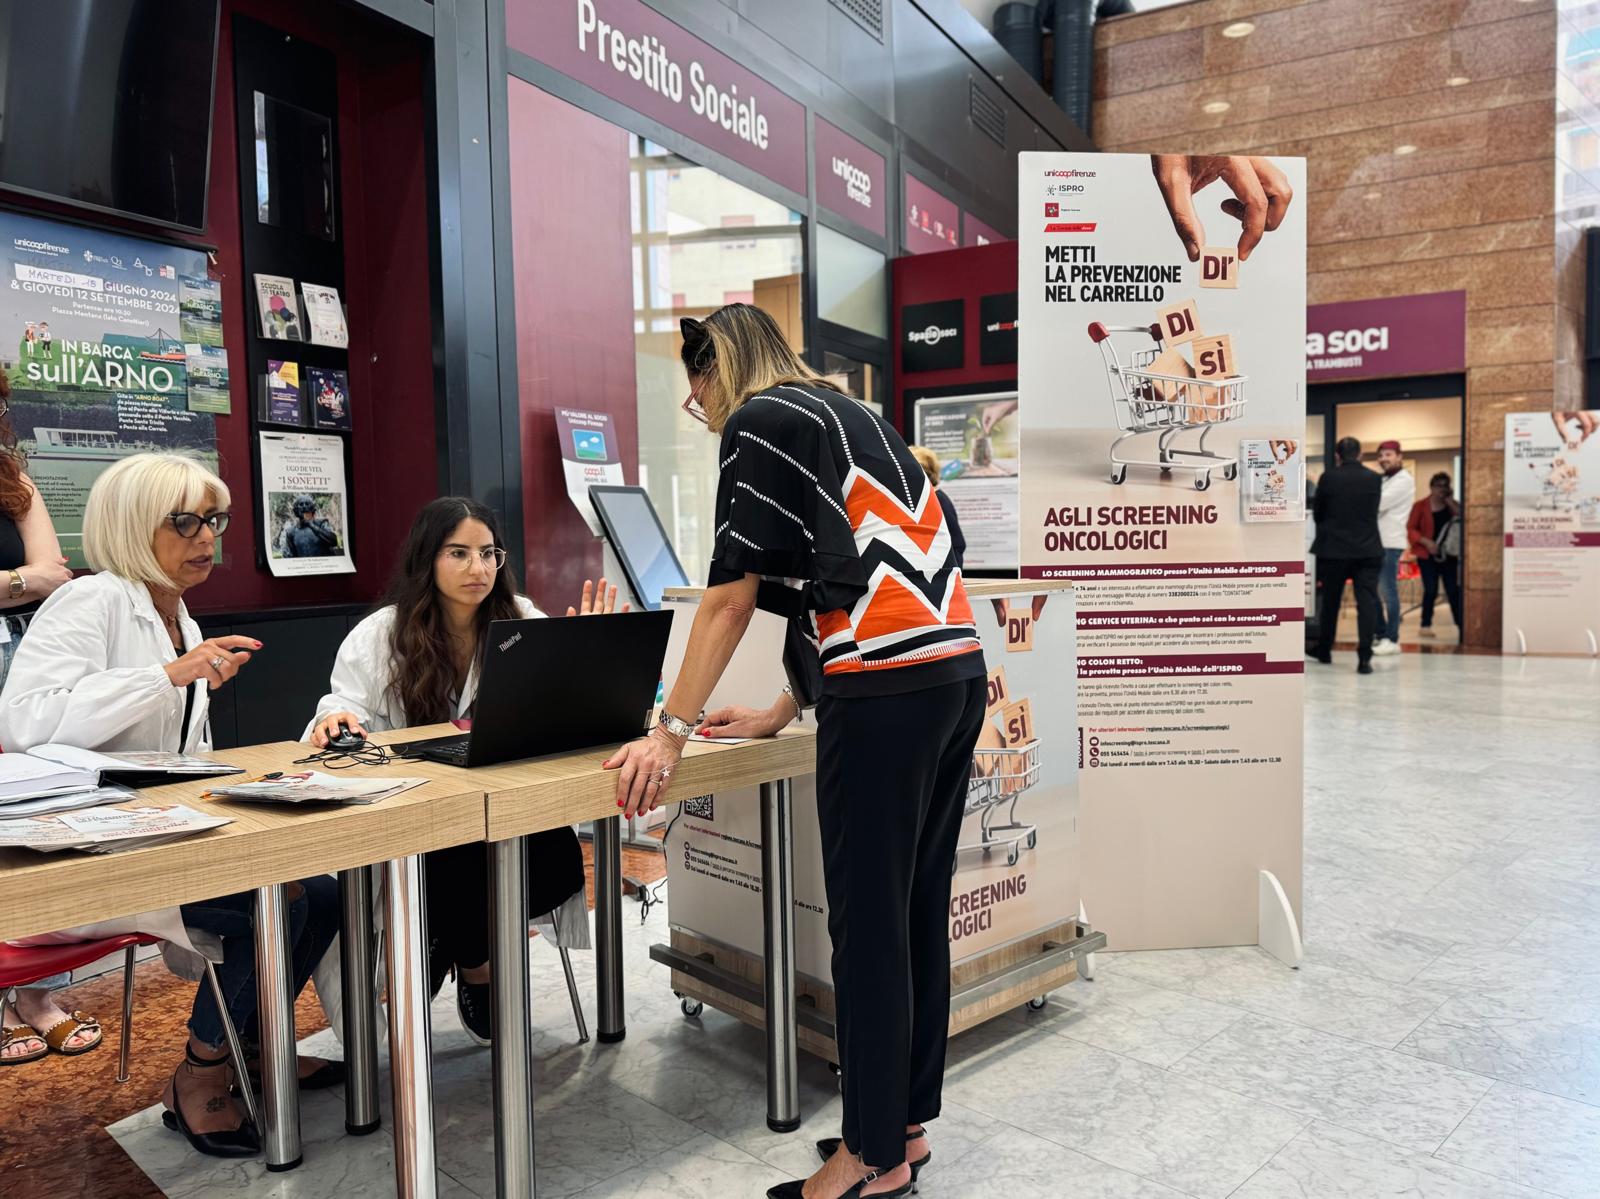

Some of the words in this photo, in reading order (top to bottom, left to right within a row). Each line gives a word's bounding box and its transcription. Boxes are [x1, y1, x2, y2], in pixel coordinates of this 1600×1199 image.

[577, 0, 682, 103] Prestito
[690, 61, 768, 150] Sociale
[832, 157, 871, 192] unicoop
[1044, 169, 1096, 178] unicoopfirenze
[14, 238, 70, 254] unicoopfirenze
[1045, 246, 1096, 263] METTI
[1045, 266, 1066, 283] LA
[1071, 265, 1182, 283] PREVENZIONE
[1203, 255, 1234, 280] DI'
[10, 280, 20, 290] &
[77, 289, 88, 300] 12
[91, 292, 152, 311] SETTEMBRE
[155, 303, 180, 314] 2024
[104, 282, 147, 297] GIUGNO
[150, 290, 176, 301] 2024
[1045, 286, 1076, 303] NEL
[1080, 285, 1164, 302] CARRELLO
[52, 306, 72, 315] Piazza
[1166, 308, 1196, 338] DI
[61, 339, 78, 353] IN
[82, 341, 134, 361] BARCA
[1327, 327, 1389, 354] soci
[1200, 341, 1226, 376] SÌ
[1314, 355, 1362, 370] TRAMBUSTI
[26, 354, 173, 393] sull'ARNO
[1044, 507, 1092, 527] AGLI
[1097, 505, 1218, 526] SCREENING
[1044, 530, 1168, 552] ONCOLOGICI
[1008, 617, 1029, 643] DI'
[1179, 616, 1200, 625] punto
[1237, 614, 1277, 623] screening?
[1089, 668, 1120, 676] provetta
[1008, 705, 1027, 744] SÌ
[950, 874, 1027, 918] CREENING
[952, 908, 992, 941] OGICI
